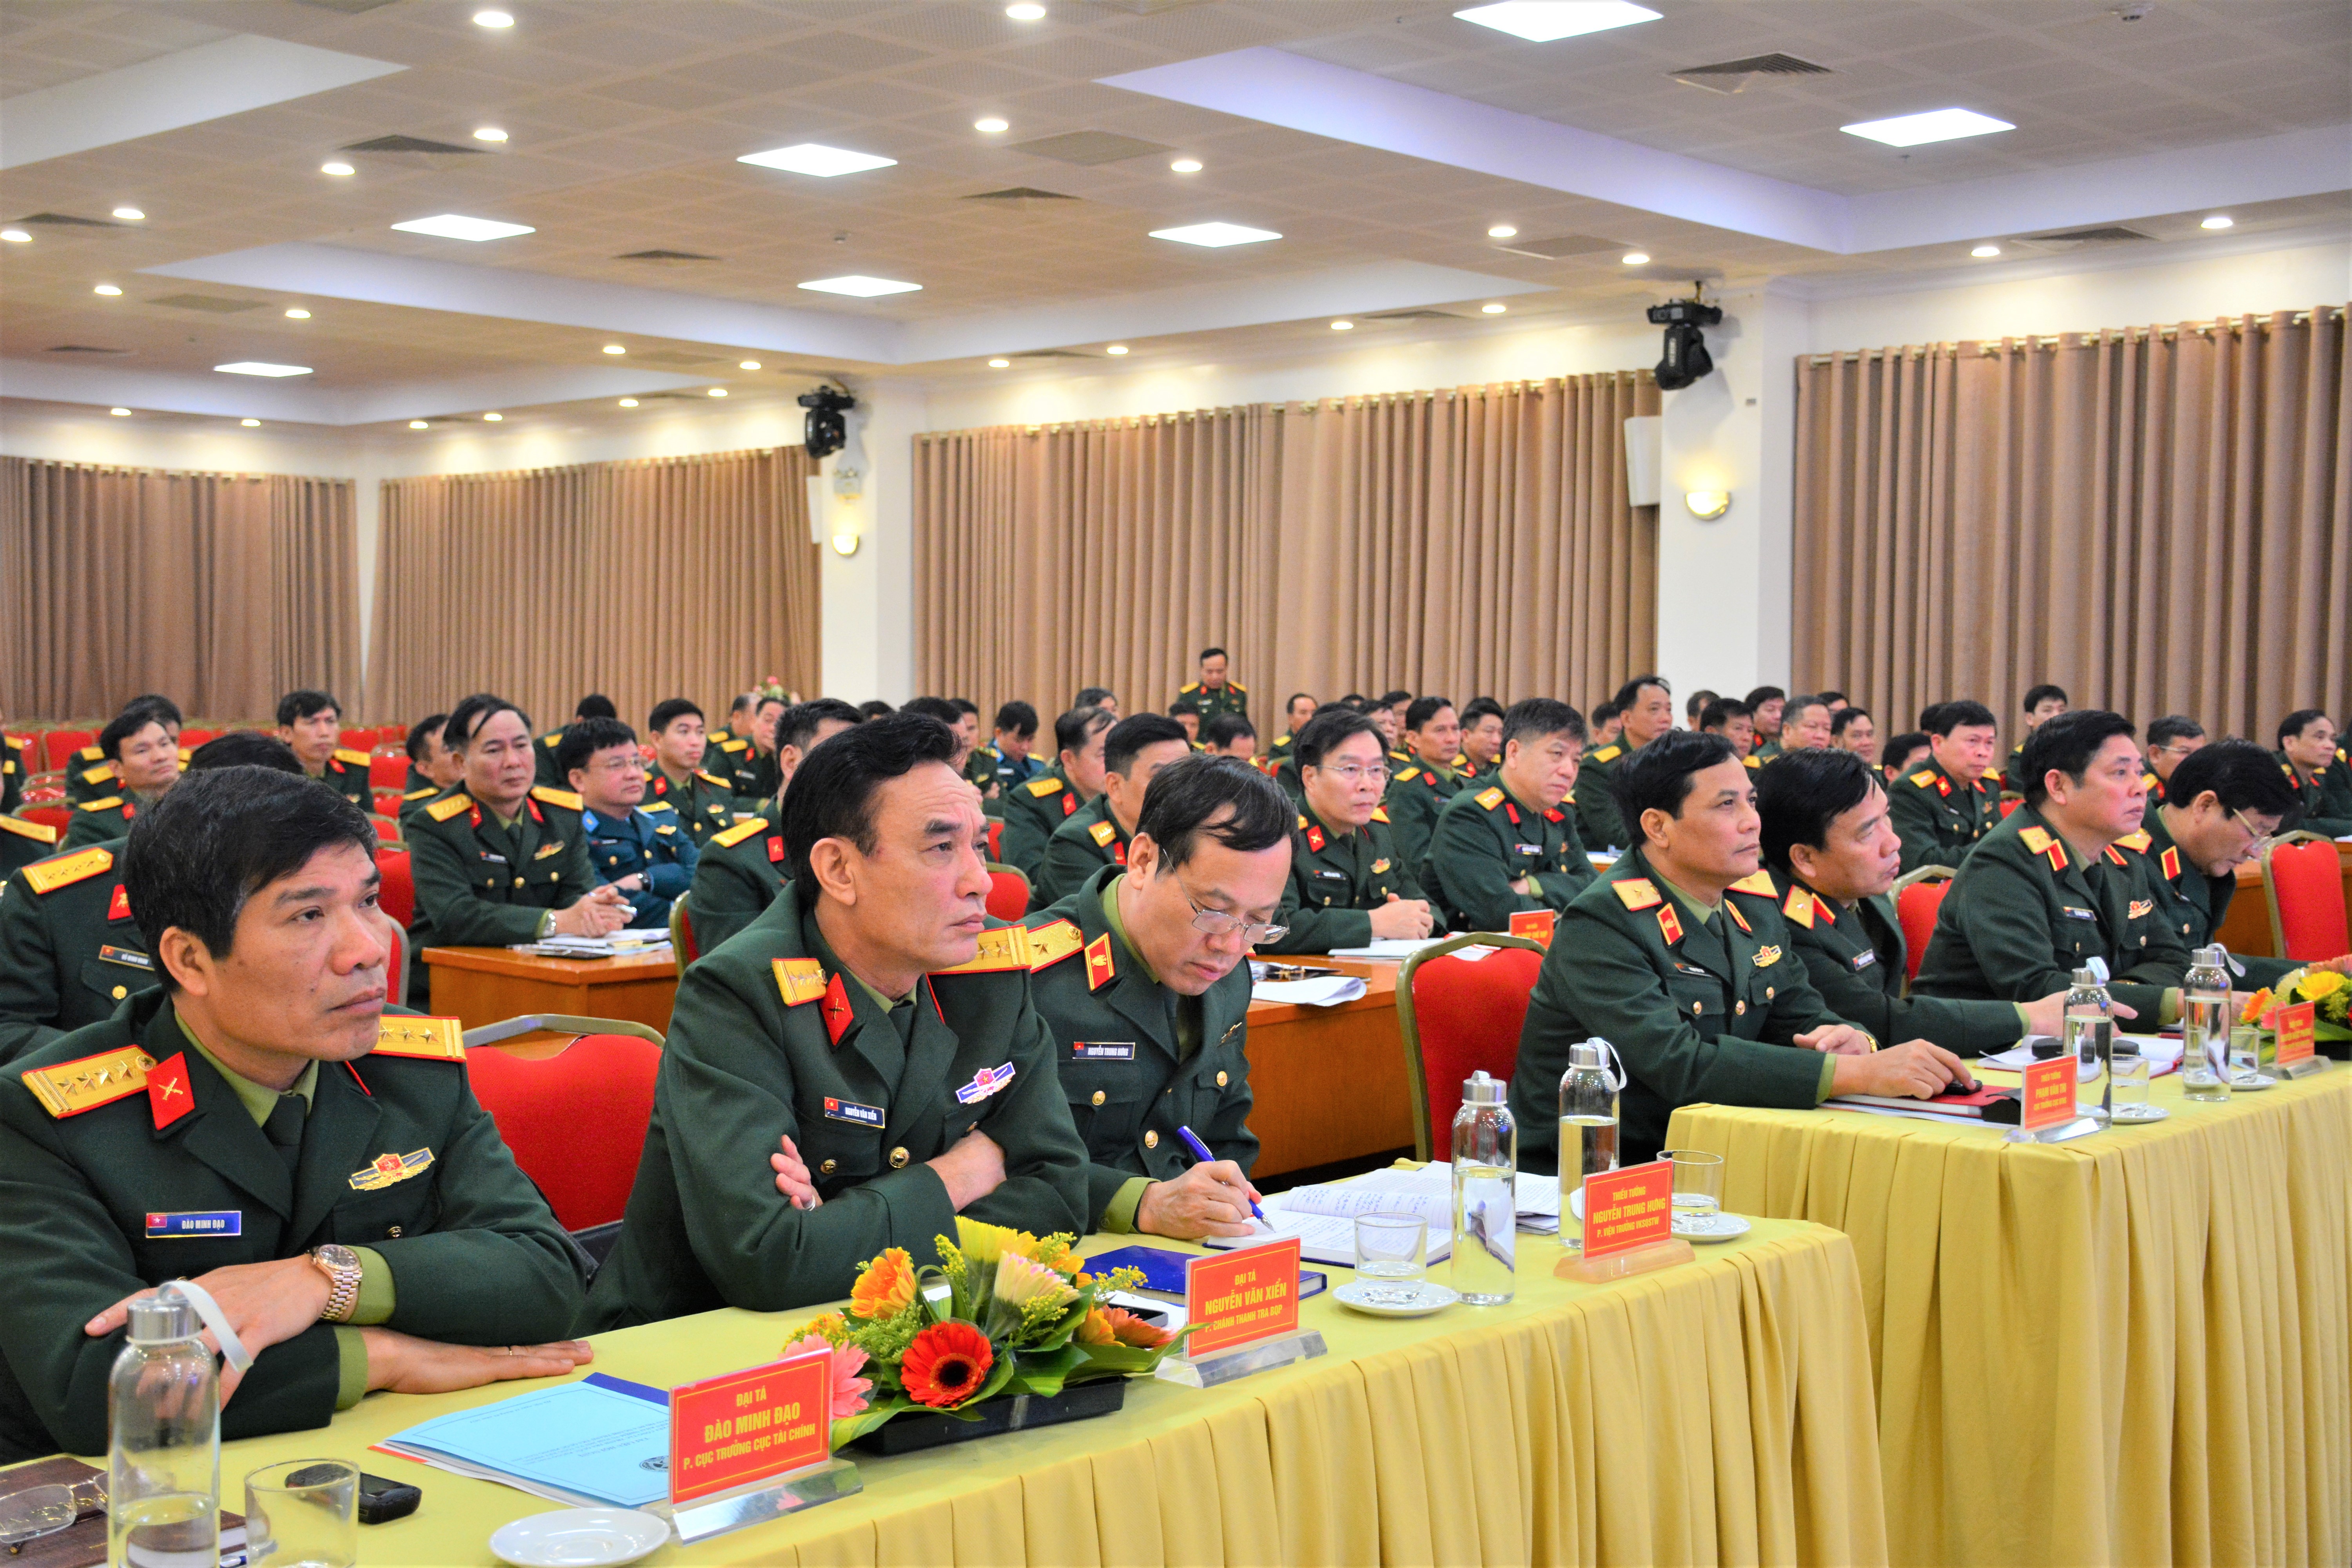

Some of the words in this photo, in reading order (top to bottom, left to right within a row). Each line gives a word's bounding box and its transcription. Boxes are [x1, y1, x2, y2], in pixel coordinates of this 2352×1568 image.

[1613, 1187, 1628, 1201] THIẾU
[1629, 1185, 1646, 1198] TƯỚNG
[1593, 1204, 1621, 1224] NGUYỄN
[1623, 1202, 1645, 1217] TRUNG
[195, 1220, 211, 1229] MINH
[212, 1220, 225, 1230] ĐẠO
[1597, 1229, 1602, 1238] P.
[1603, 1225, 1615, 1237] VIỆN
[1616, 1220, 1635, 1234] TRƯỞNG
[1636, 1216, 1659, 1229] VKSQSTW
[1235, 1273, 1246, 1286] ĐẠI
[1248, 1269, 1256, 1282] TÁ
[1205, 1289, 1242, 1315] NGUYỄN
[1245, 1287, 1263, 1305] VĂN
[1265, 1278, 1287, 1300] XIỂN
[1213, 1316, 1234, 1330] CHÁNH
[1236, 1311, 1256, 1324] THANH
[1258, 1308, 1269, 1319] TRA
[1270, 1304, 1283, 1316] BQP
[736, 1391, 752, 1407] ĐẠI
[755, 1385, 766, 1402] TÁ
[705, 1419, 732, 1443] ĐÀO
[736, 1409, 770, 1435] MINH
[774, 1402, 800, 1425] ĐẠO
[684, 1458, 693, 1470] P.
[696, 1451, 713, 1467] CỤC
[716, 1439, 751, 1460] TRƯỞNG
[754, 1436, 771, 1451] CỤC
[773, 1430, 786, 1445] TÀI
[789, 1423, 815, 1441] CHÍNH
